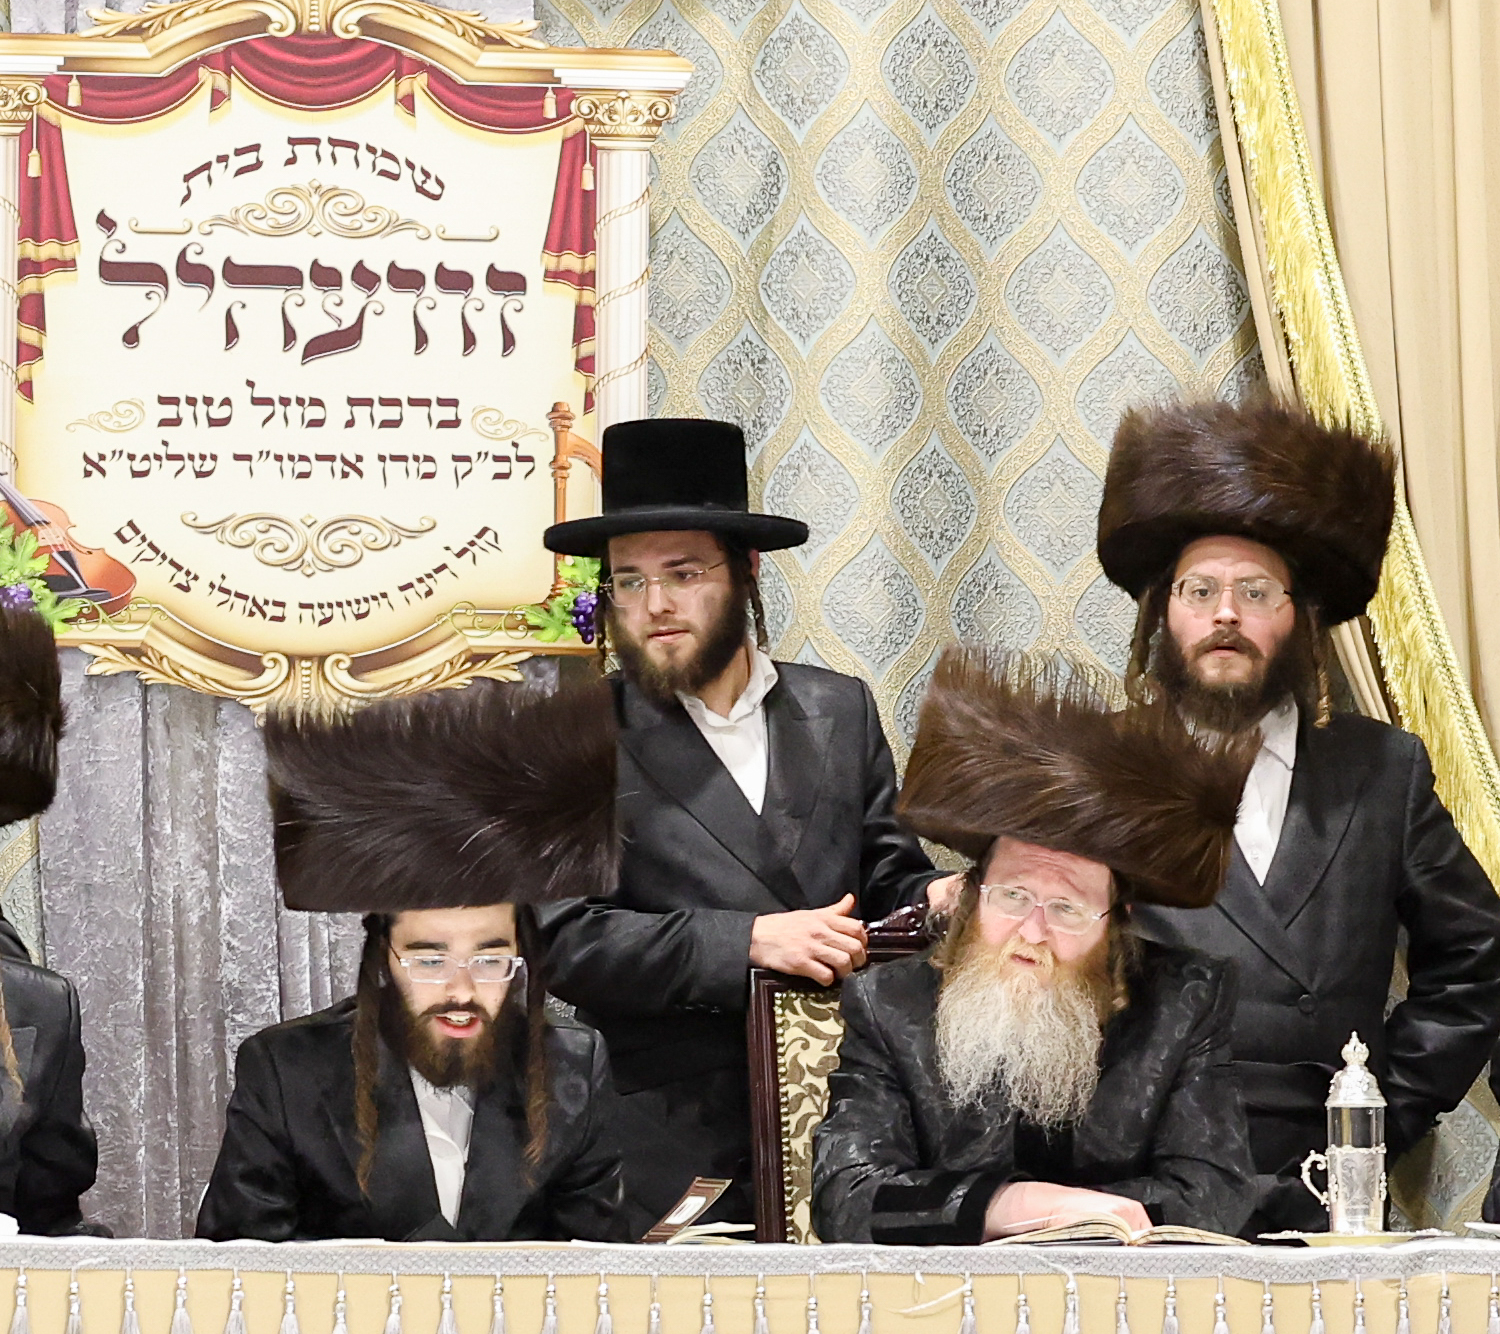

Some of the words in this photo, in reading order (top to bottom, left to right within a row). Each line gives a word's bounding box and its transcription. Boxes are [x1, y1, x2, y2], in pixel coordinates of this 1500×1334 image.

[179, 142, 264, 208] בית
[283, 135, 446, 201] שמחת
[156, 393, 234, 430] טוב
[244, 378, 328, 430] מזל
[344, 394, 462, 430] ברכת
[377, 451, 439, 489] מרן
[112, 518, 201, 594] צדיקים
[443, 525, 503, 566] קול
[208, 573, 288, 624] באהלי
[397, 562, 460, 606] רינה
[298, 591, 395, 627] וישועה
